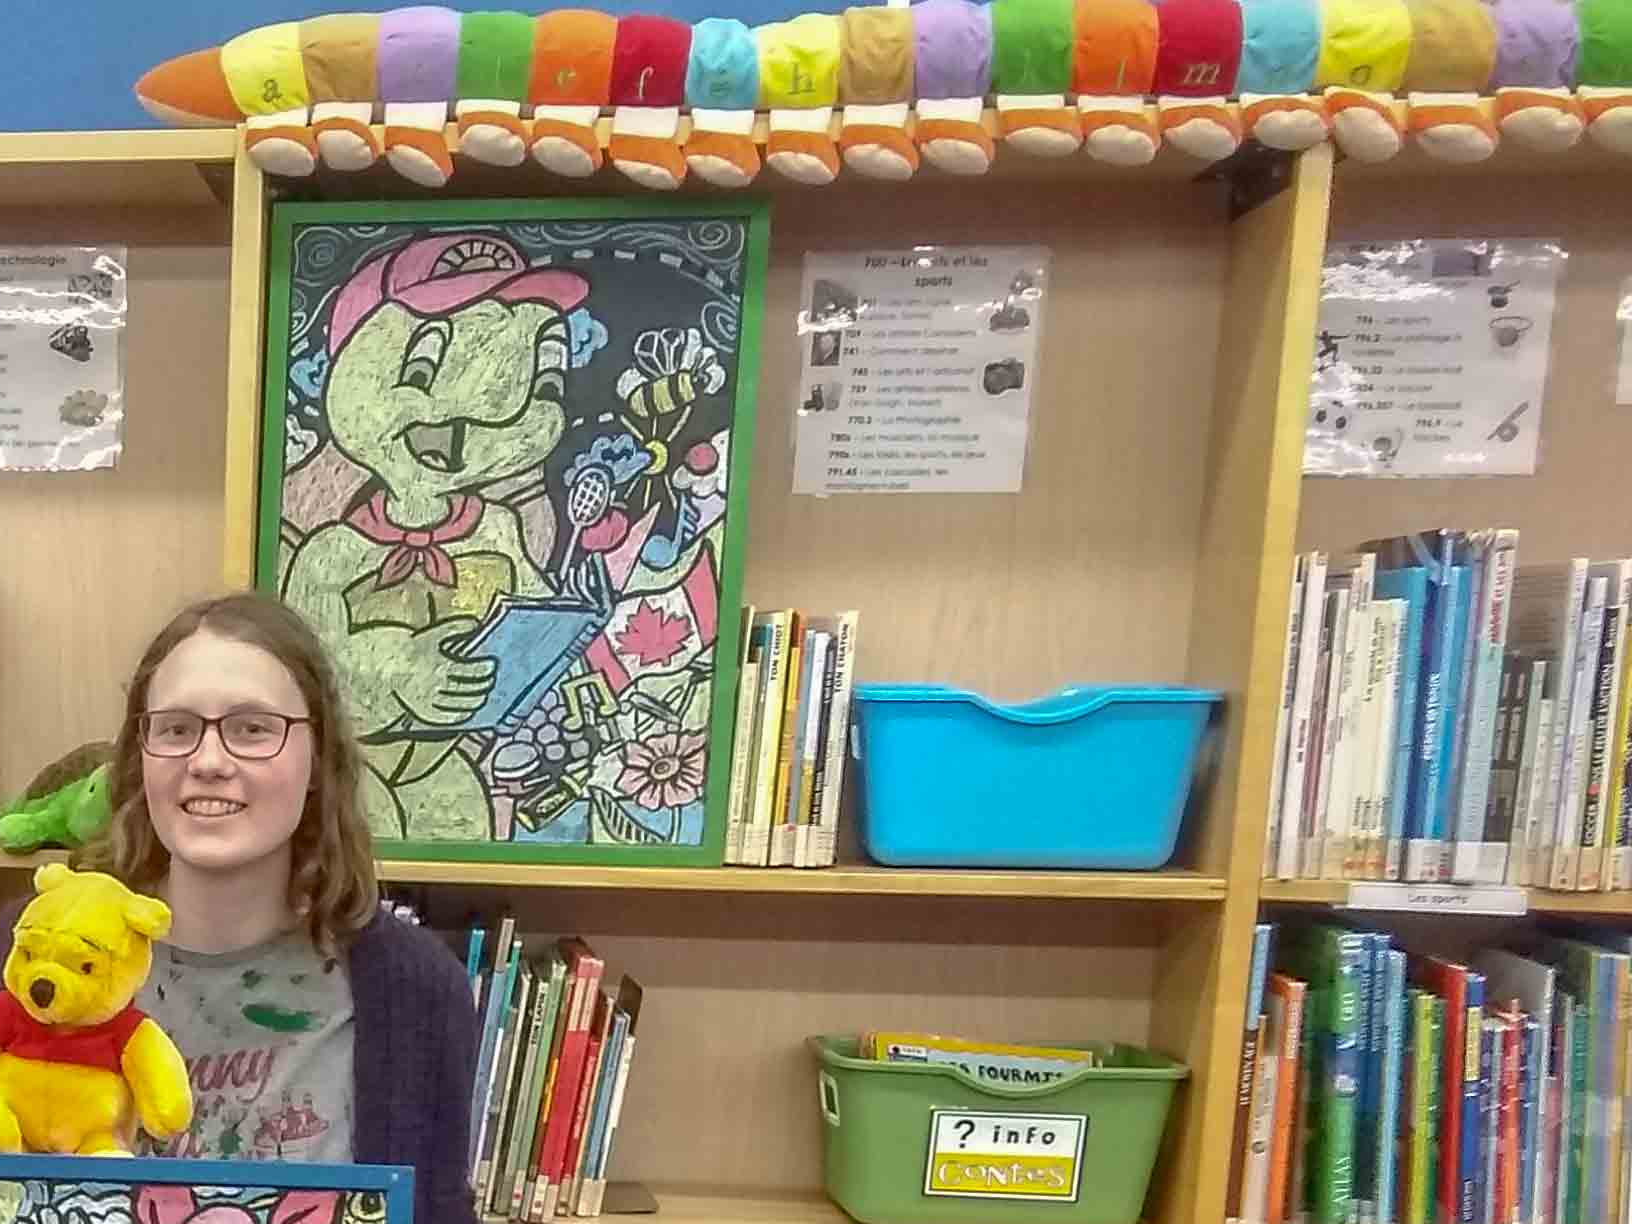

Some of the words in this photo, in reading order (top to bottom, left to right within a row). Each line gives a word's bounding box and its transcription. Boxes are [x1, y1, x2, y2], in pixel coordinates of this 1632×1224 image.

[785, 62, 817, 96] h
[1182, 62, 1221, 86] m
[1349, 64, 1372, 87] o
[914, 275, 954, 288] sports
